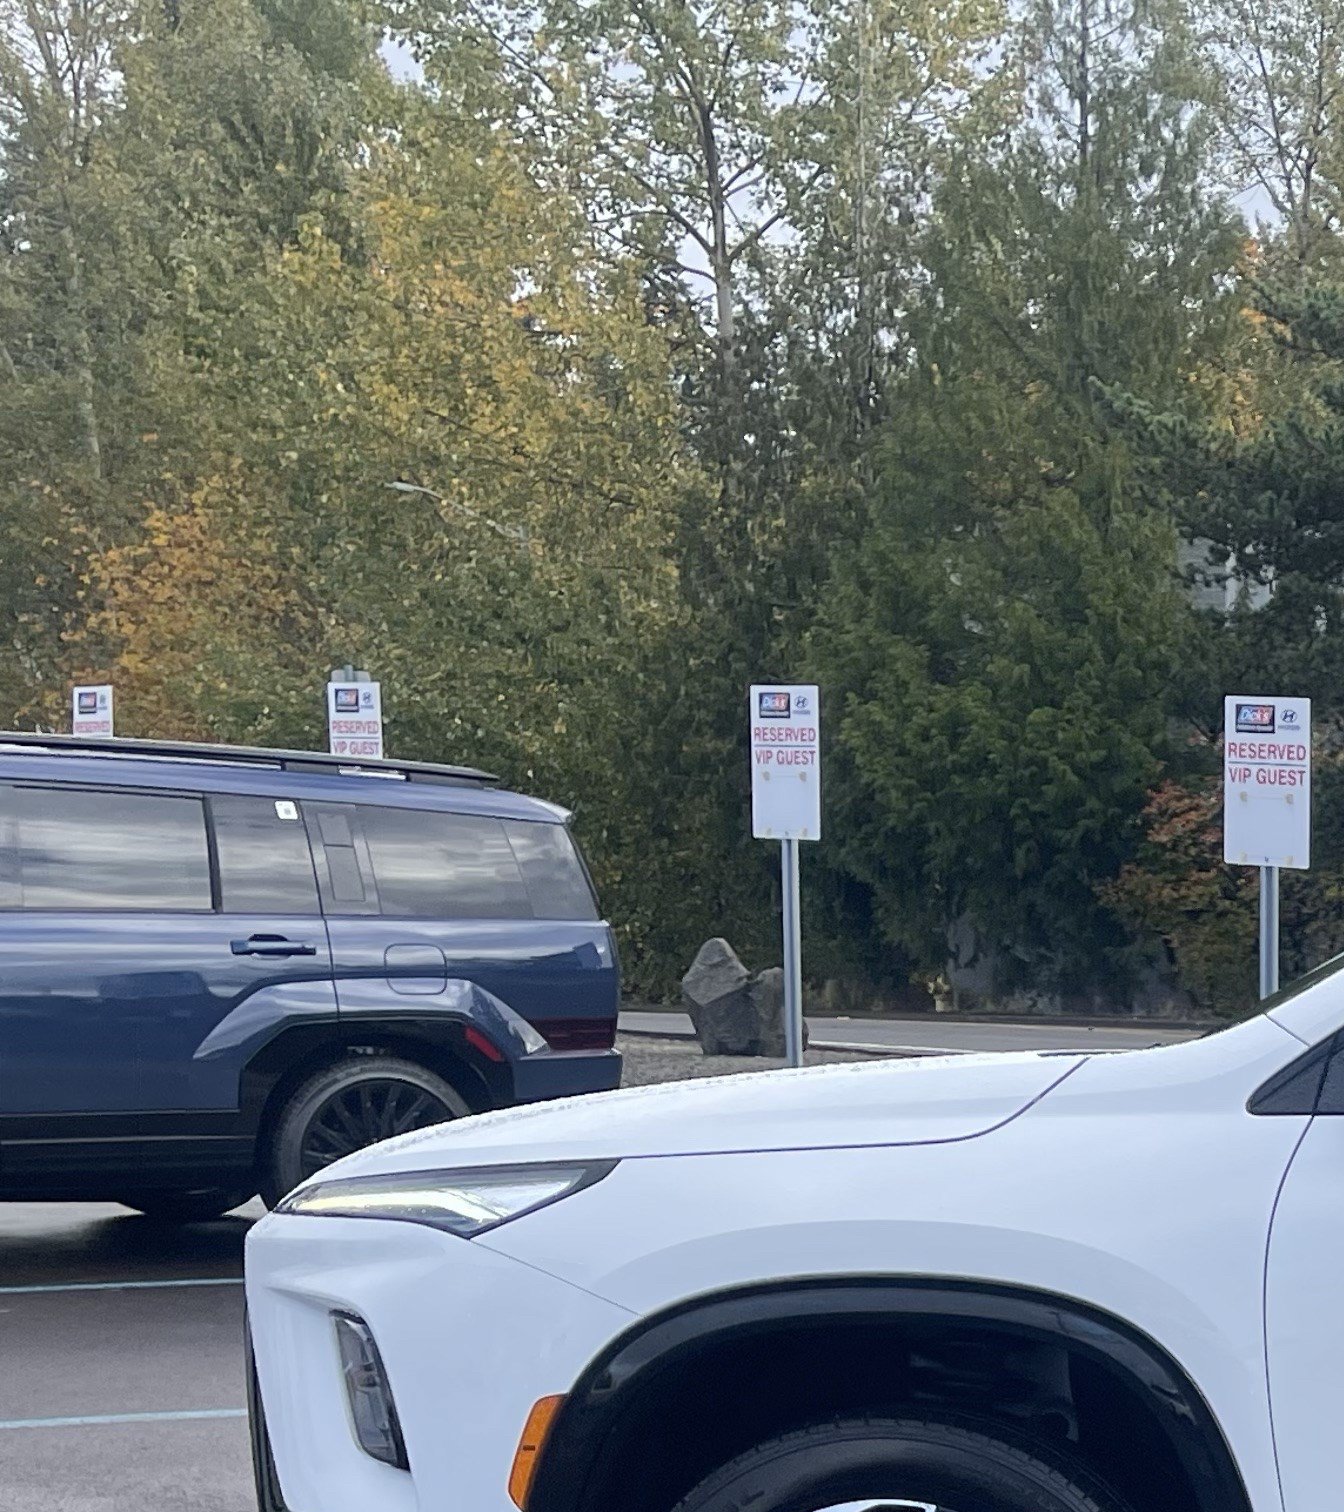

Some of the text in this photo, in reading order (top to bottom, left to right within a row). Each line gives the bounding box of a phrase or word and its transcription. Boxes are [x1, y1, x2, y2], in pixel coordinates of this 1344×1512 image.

[753, 726, 817, 742] RESERVED
[349, 741, 380, 755] GUEST
[1228, 741, 1307, 761] RESERVED
[755, 749, 817, 765] VIP GUEST
[1228, 766, 1307, 786] VIP GUEST
